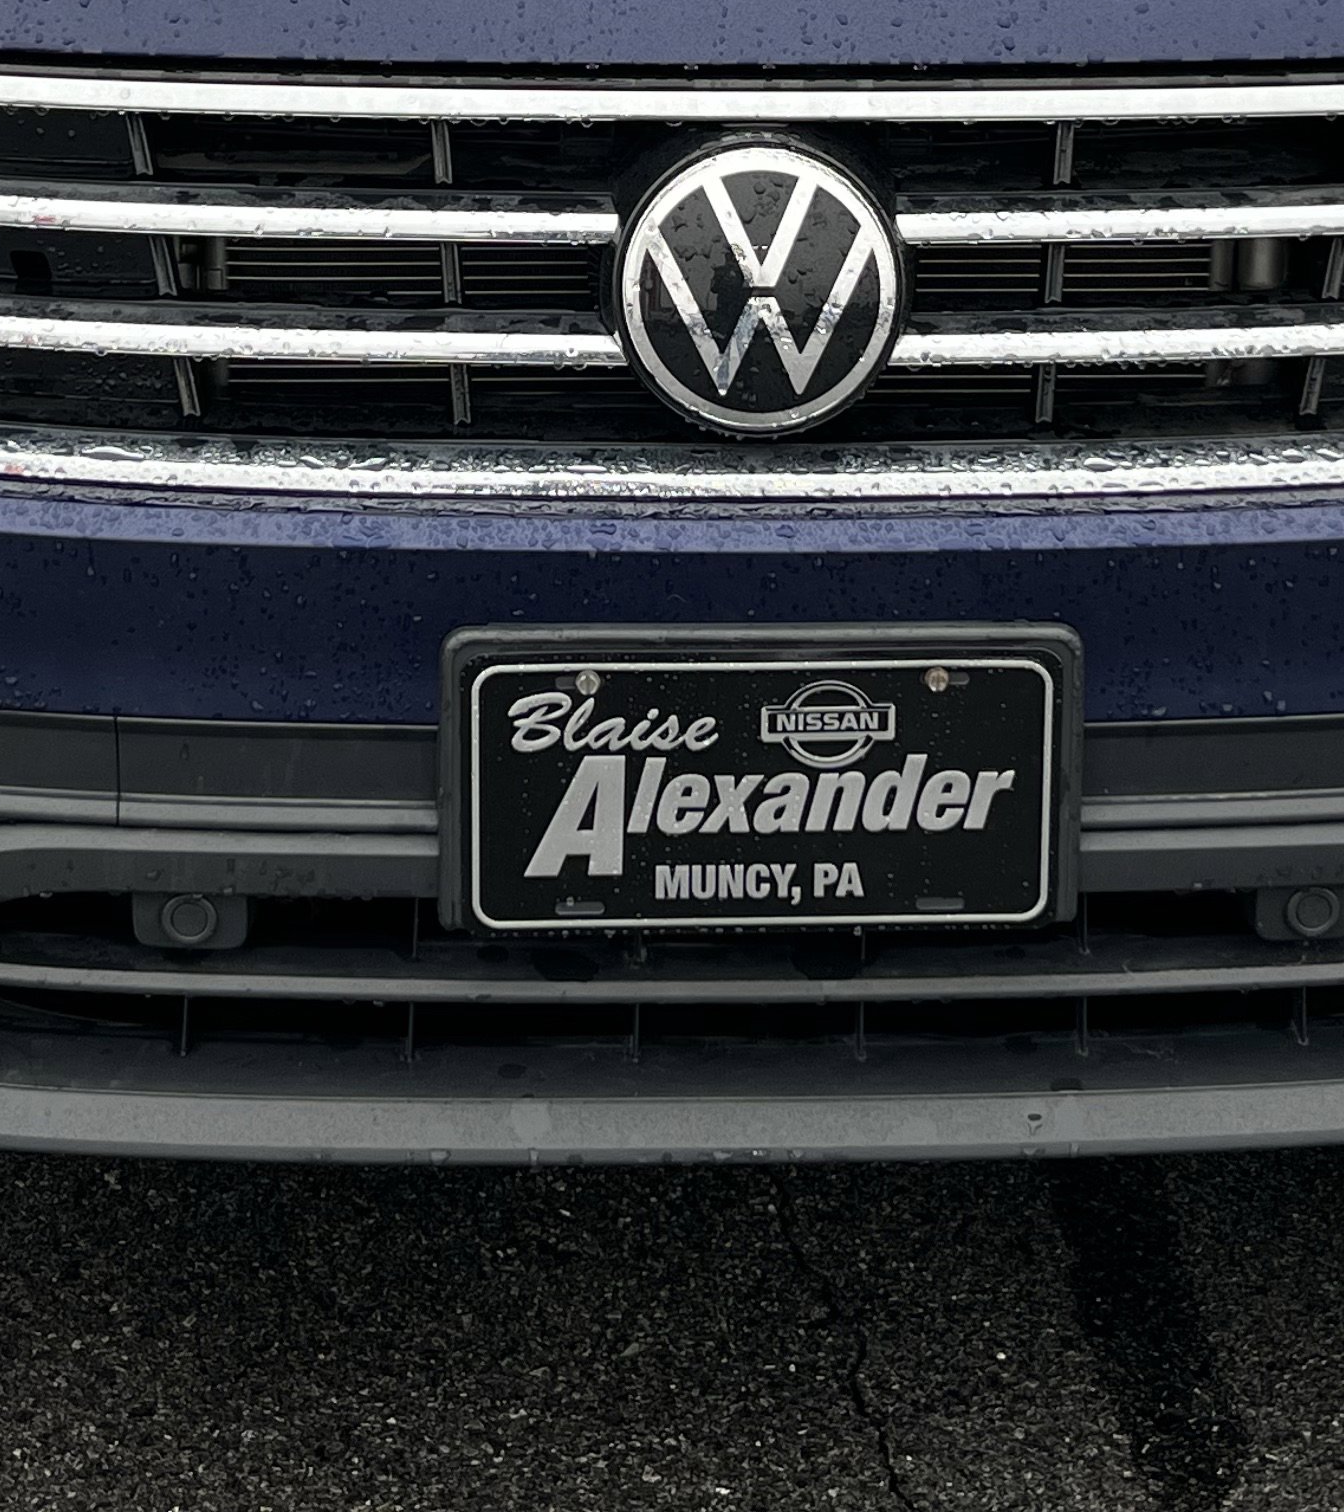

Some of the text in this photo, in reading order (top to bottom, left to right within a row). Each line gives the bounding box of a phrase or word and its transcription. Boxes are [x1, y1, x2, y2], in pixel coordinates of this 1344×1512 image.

[507, 691, 719, 752] Blaise
[776, 711, 879, 733] NISSAN
[524, 753, 1015, 878] Alexander
[655, 861, 864, 906] MUNCY, PA
